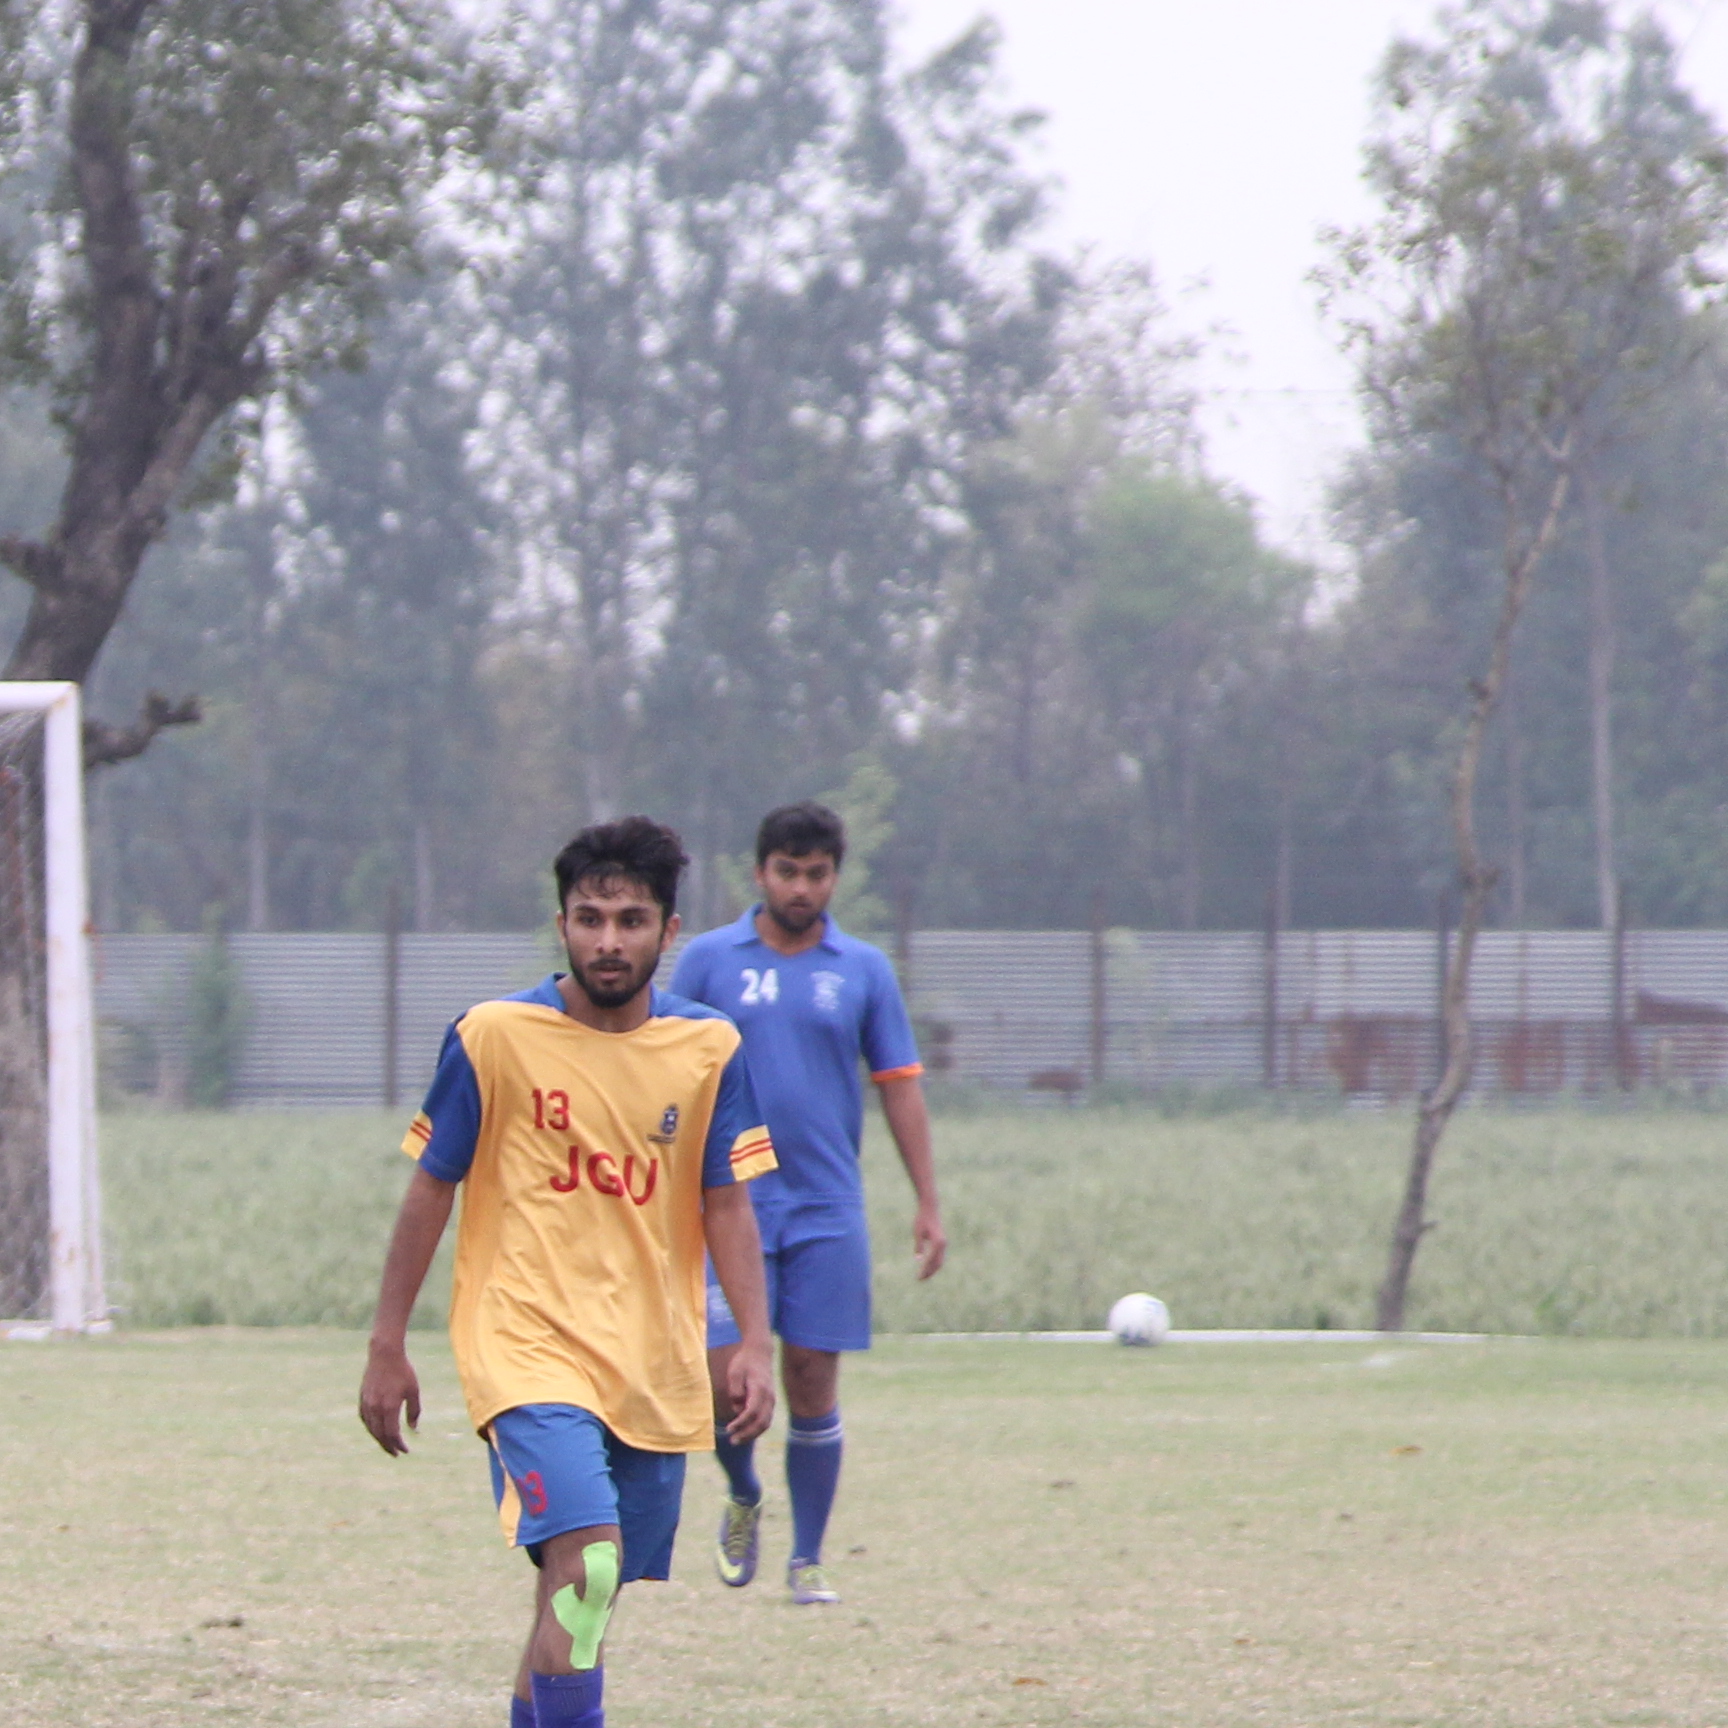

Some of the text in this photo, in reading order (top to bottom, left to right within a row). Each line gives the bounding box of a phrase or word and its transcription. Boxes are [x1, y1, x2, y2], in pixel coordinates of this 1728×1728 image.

[739, 967, 780, 1005] 24
[532, 1088, 570, 1131] 13
[549, 1144, 659, 1206] JGU
[515, 1470, 549, 1517] 13
